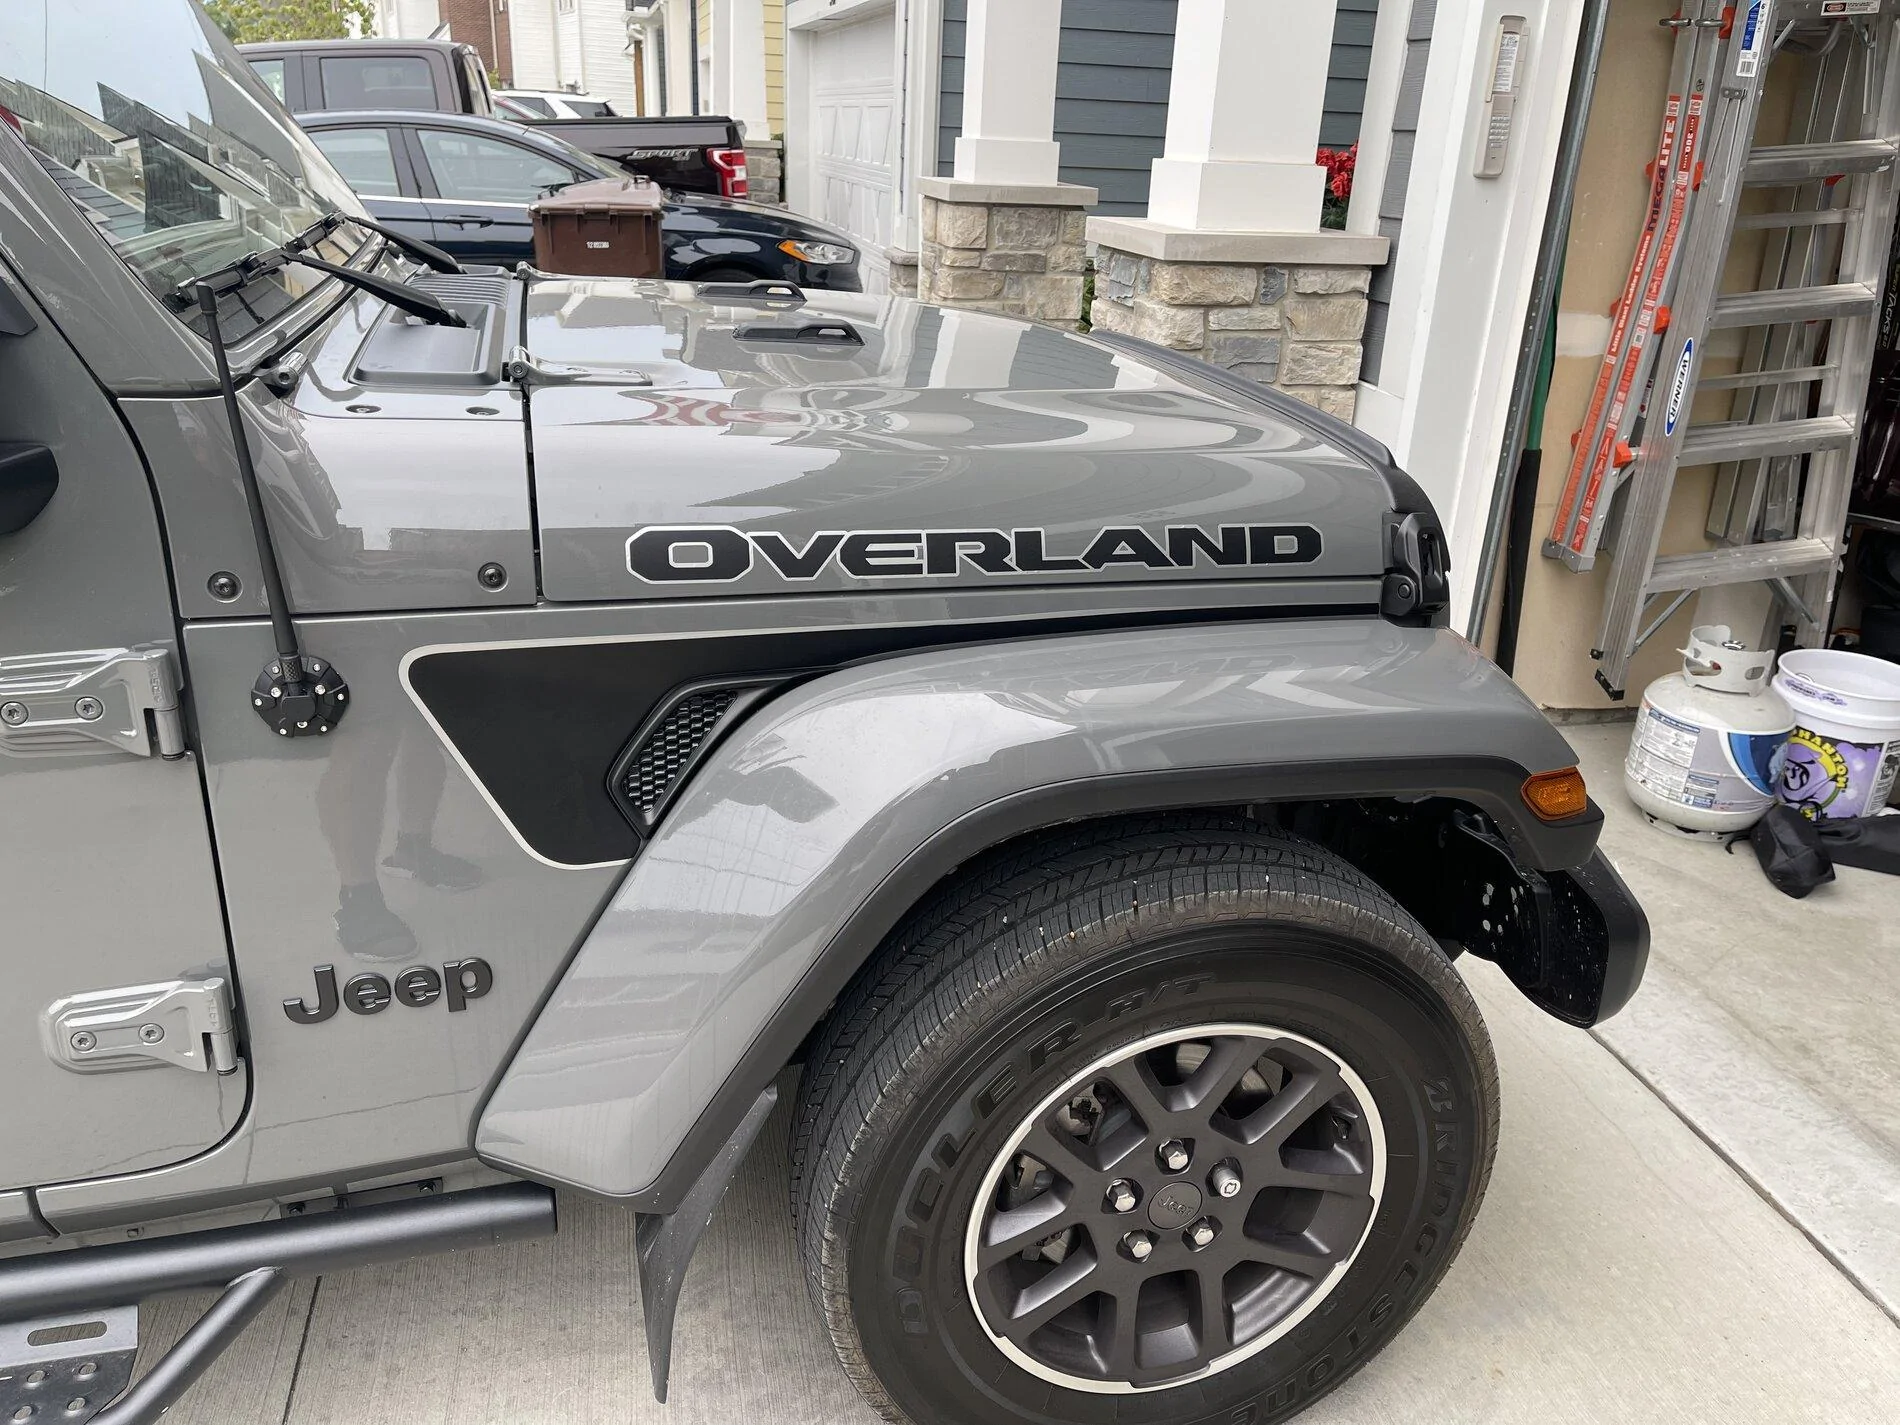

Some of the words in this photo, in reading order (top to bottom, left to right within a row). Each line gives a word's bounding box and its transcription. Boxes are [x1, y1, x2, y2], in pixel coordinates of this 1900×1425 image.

[1670, 359, 1689, 417] WERNER
[625, 524, 1323, 584] OVERLAND
[283, 957, 493, 1025] Jeep
[892, 1021, 1082, 1335] DUELER
